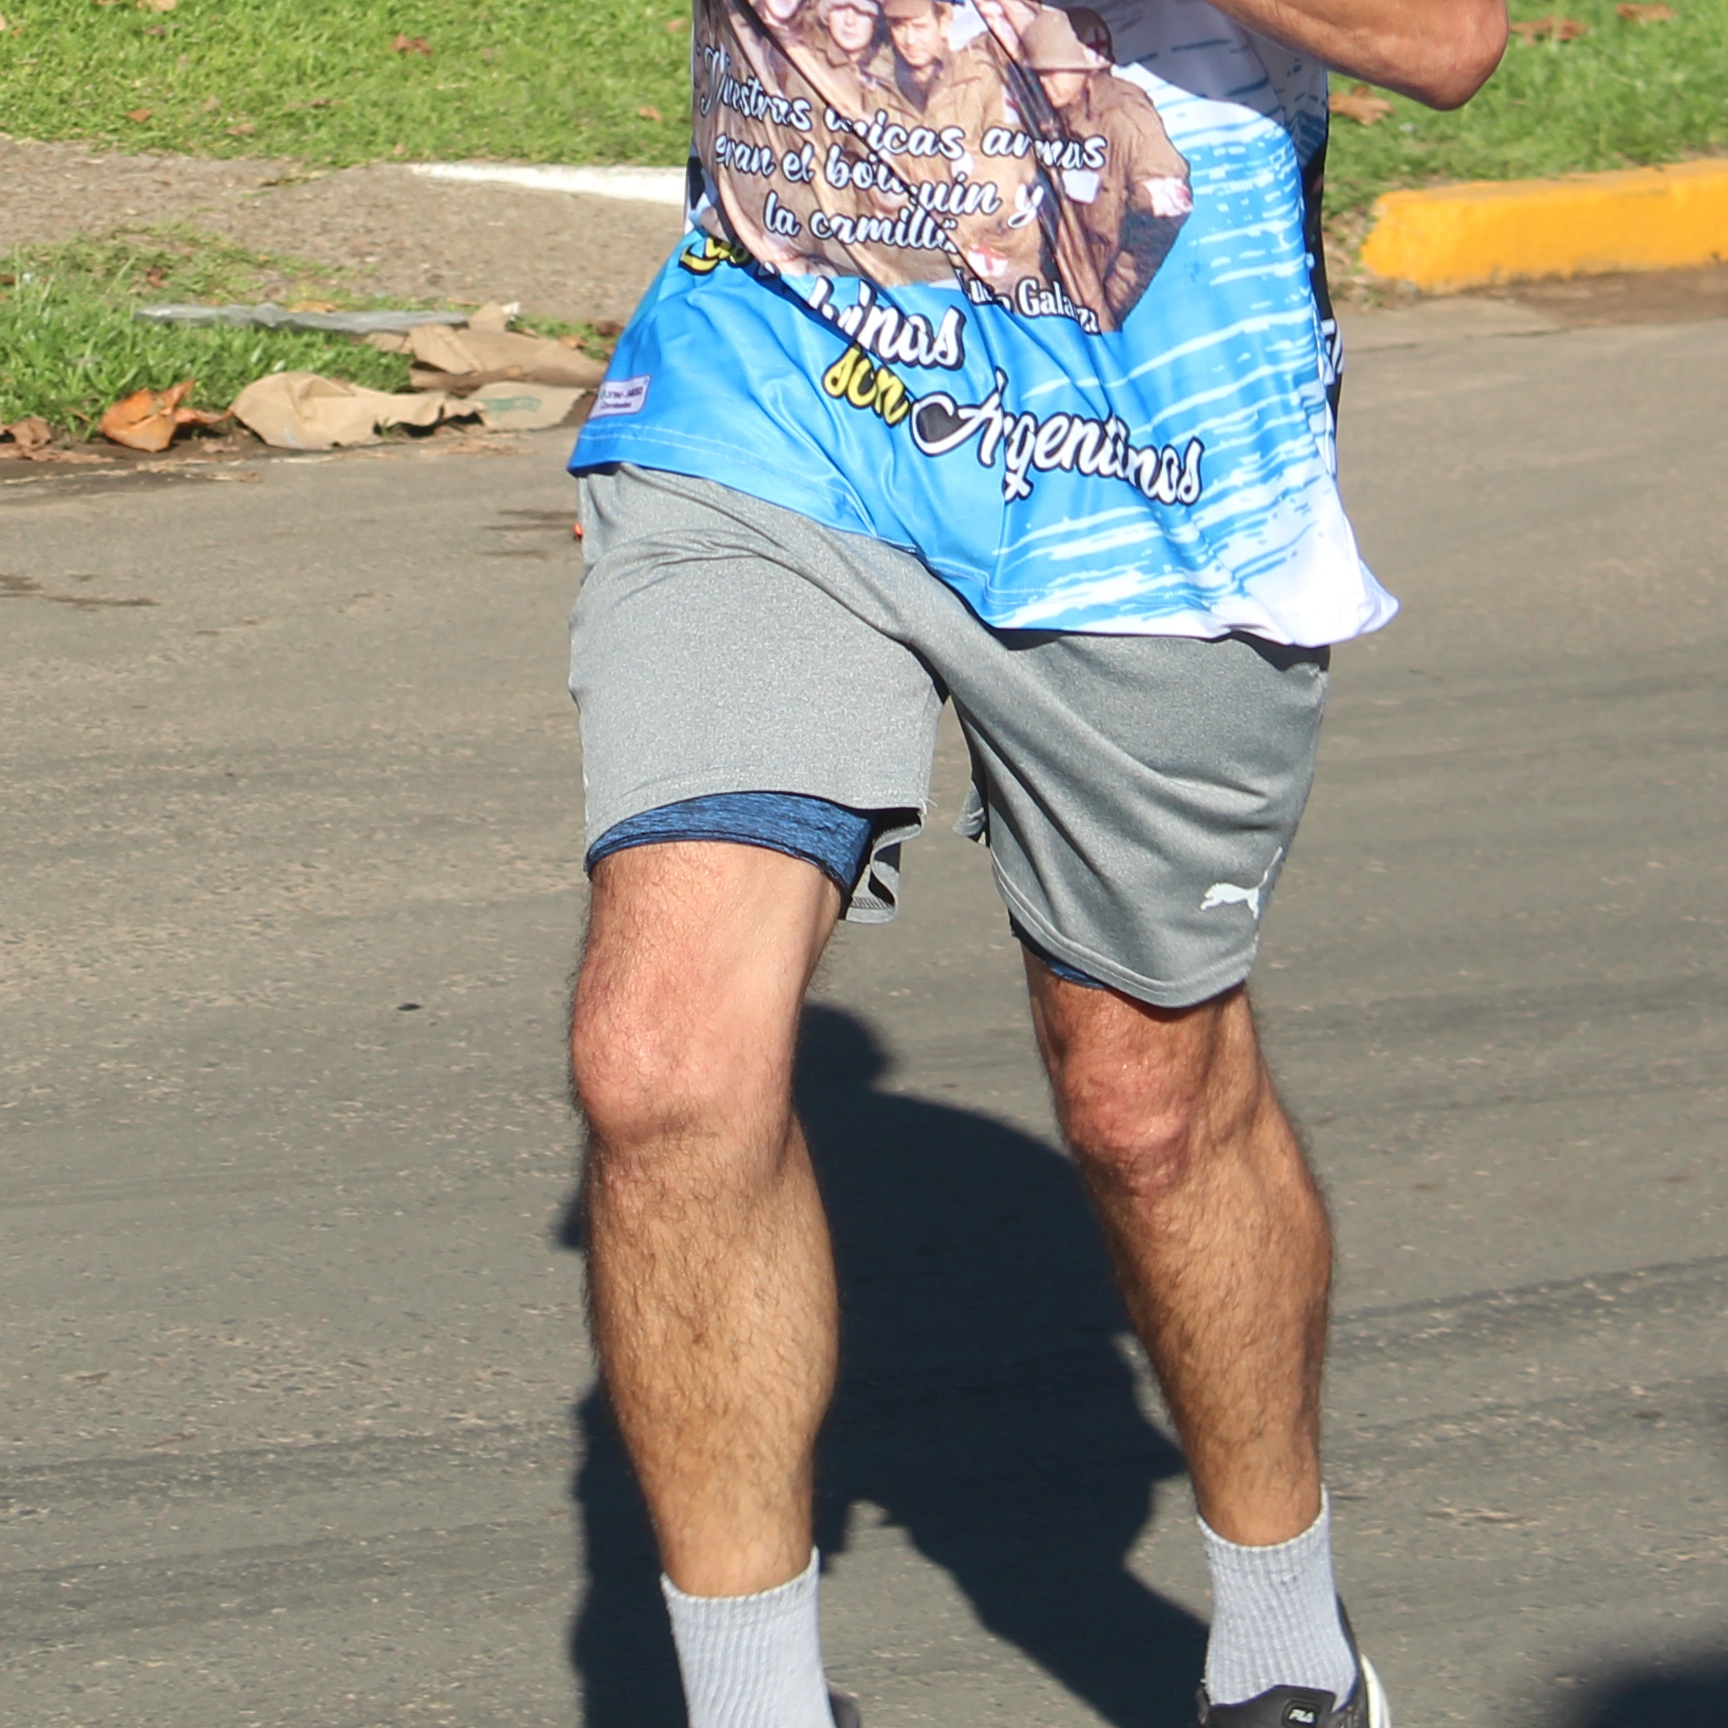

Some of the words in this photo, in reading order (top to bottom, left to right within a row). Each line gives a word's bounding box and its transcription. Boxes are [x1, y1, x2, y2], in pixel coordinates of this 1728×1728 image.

[714, 133, 776, 178] eran
[782, 141, 815, 183] el
[1006, 181, 1045, 229] y
[763, 190, 799, 238] la
[823, 343, 913, 428] son
